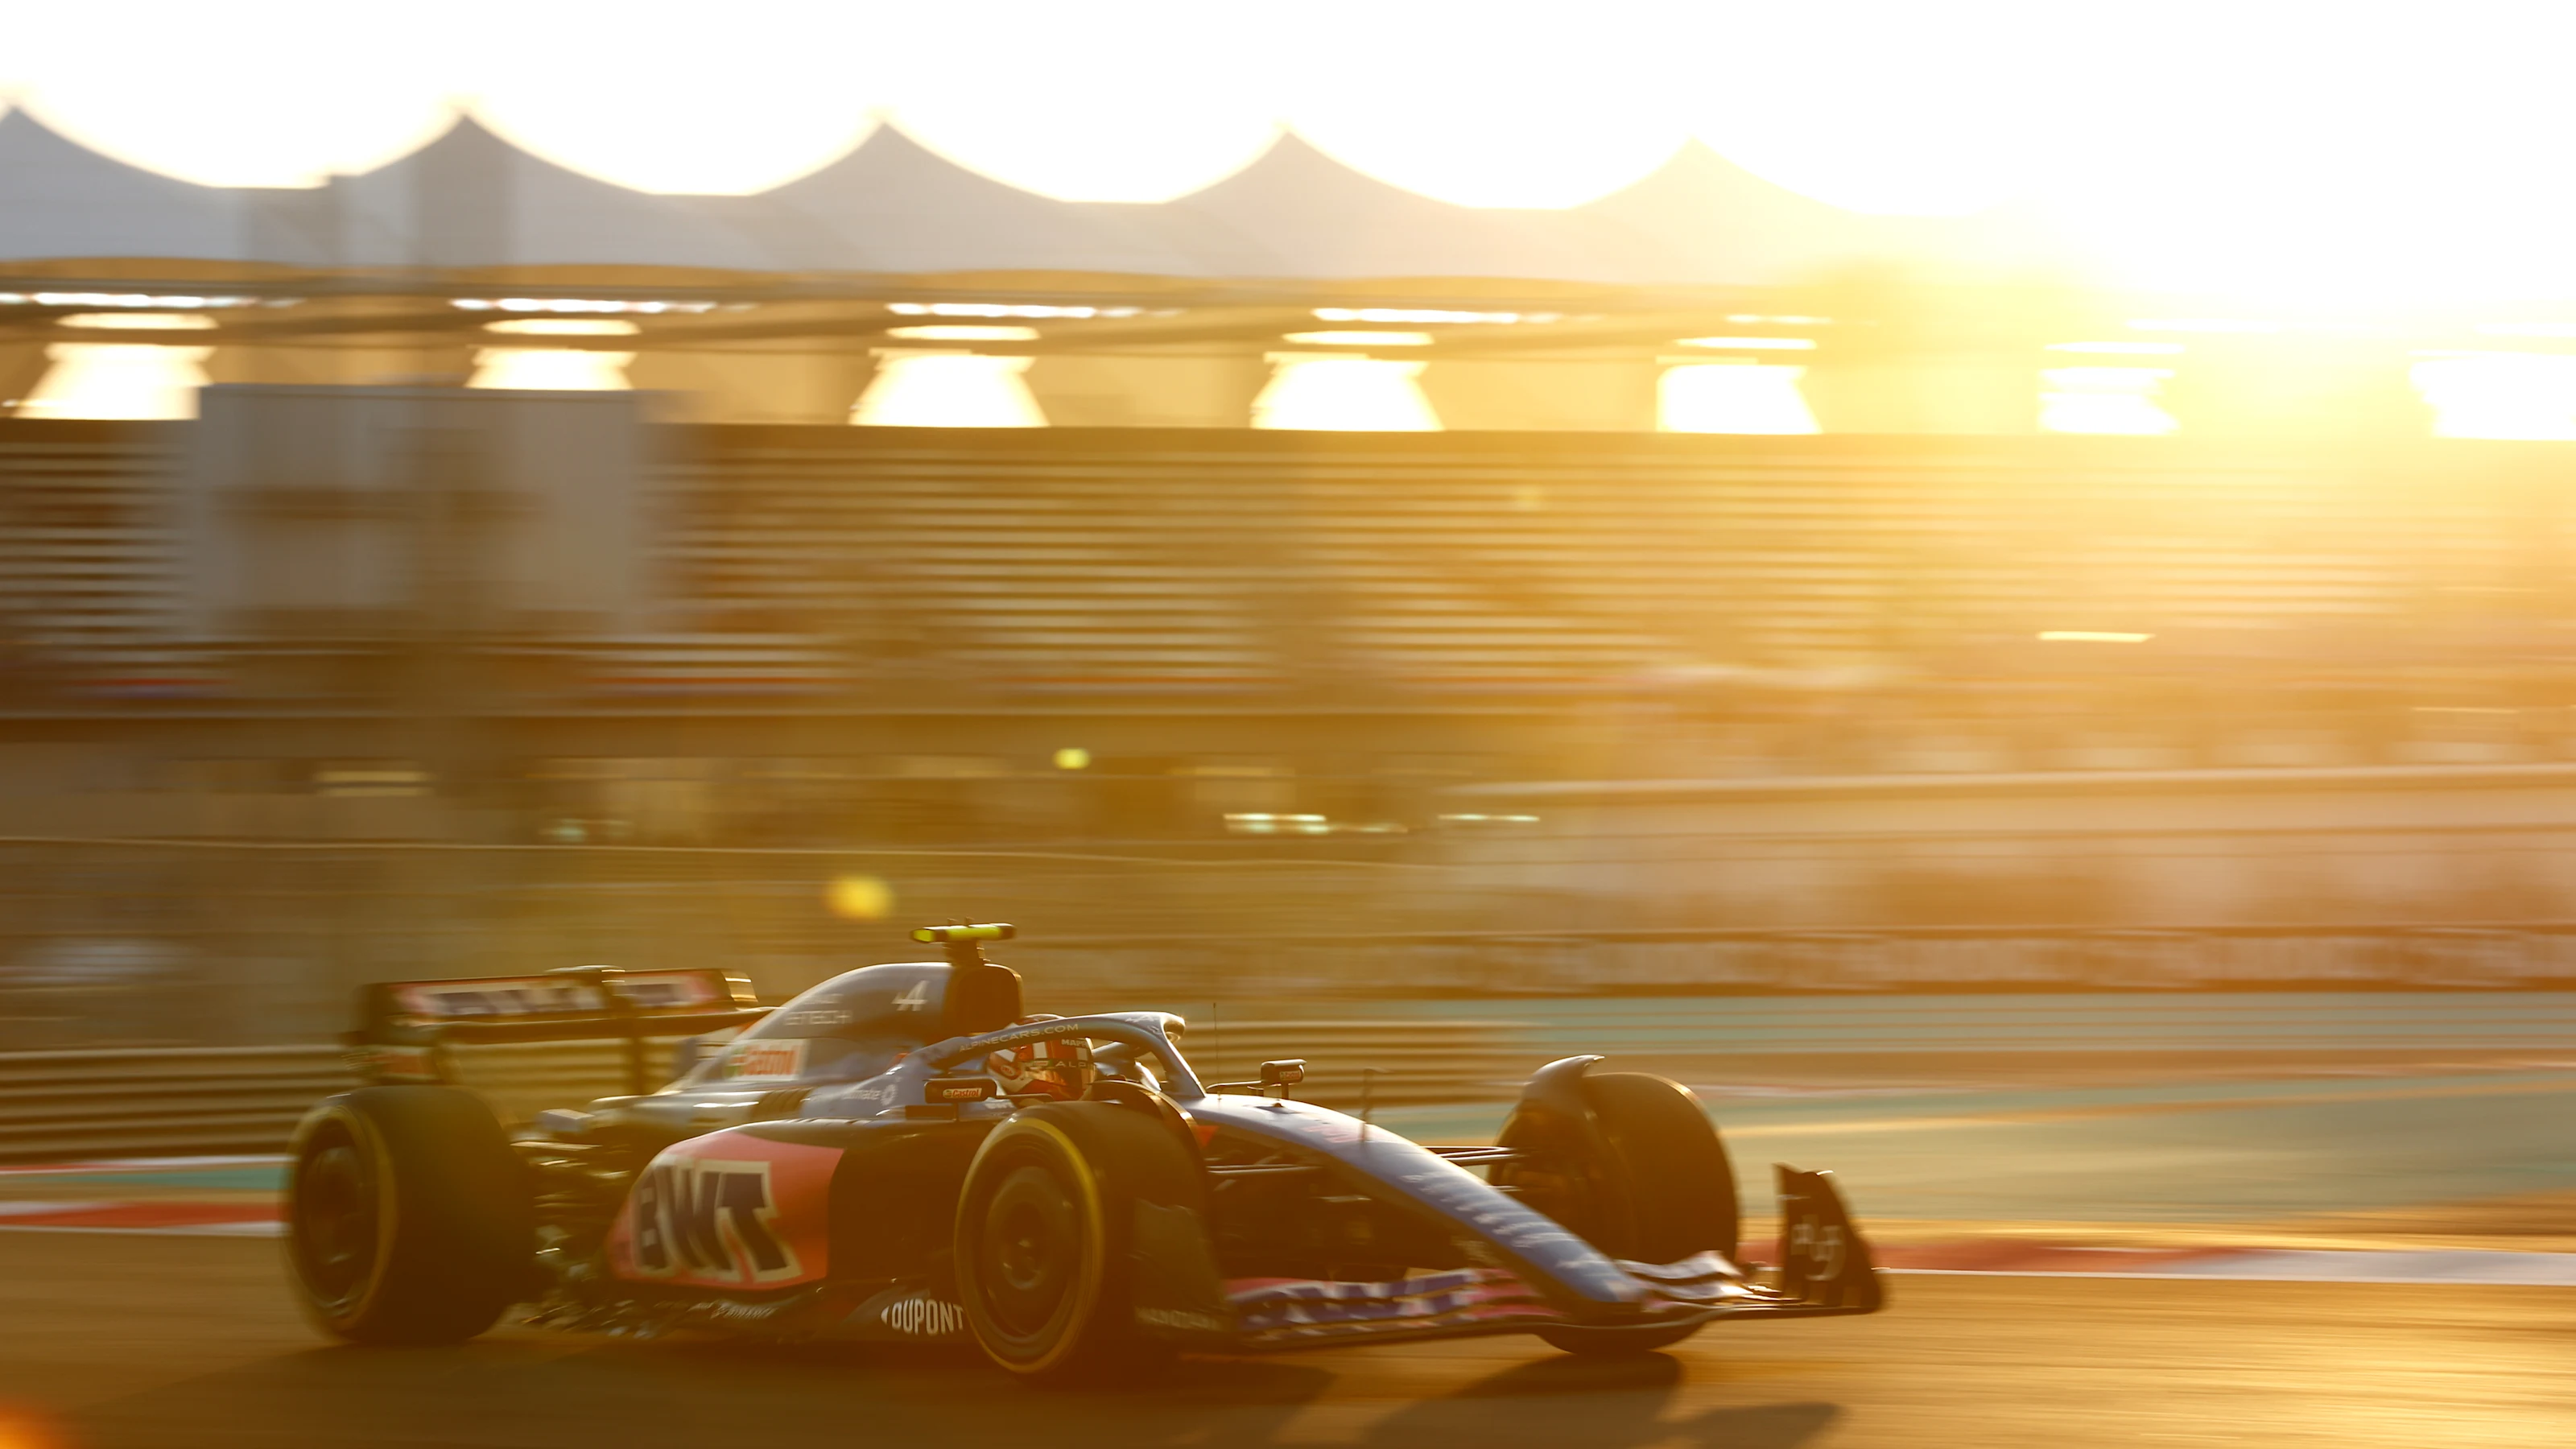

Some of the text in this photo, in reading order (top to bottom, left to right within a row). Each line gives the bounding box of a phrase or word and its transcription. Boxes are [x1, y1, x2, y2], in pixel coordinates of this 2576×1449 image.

[959, 1023, 1079, 1053] ALPINECARS.COM
[952, 1088, 980, 1097] Castrol
[632, 1156, 802, 1282] BWT
[891, 1298, 964, 1335] DUPONT
